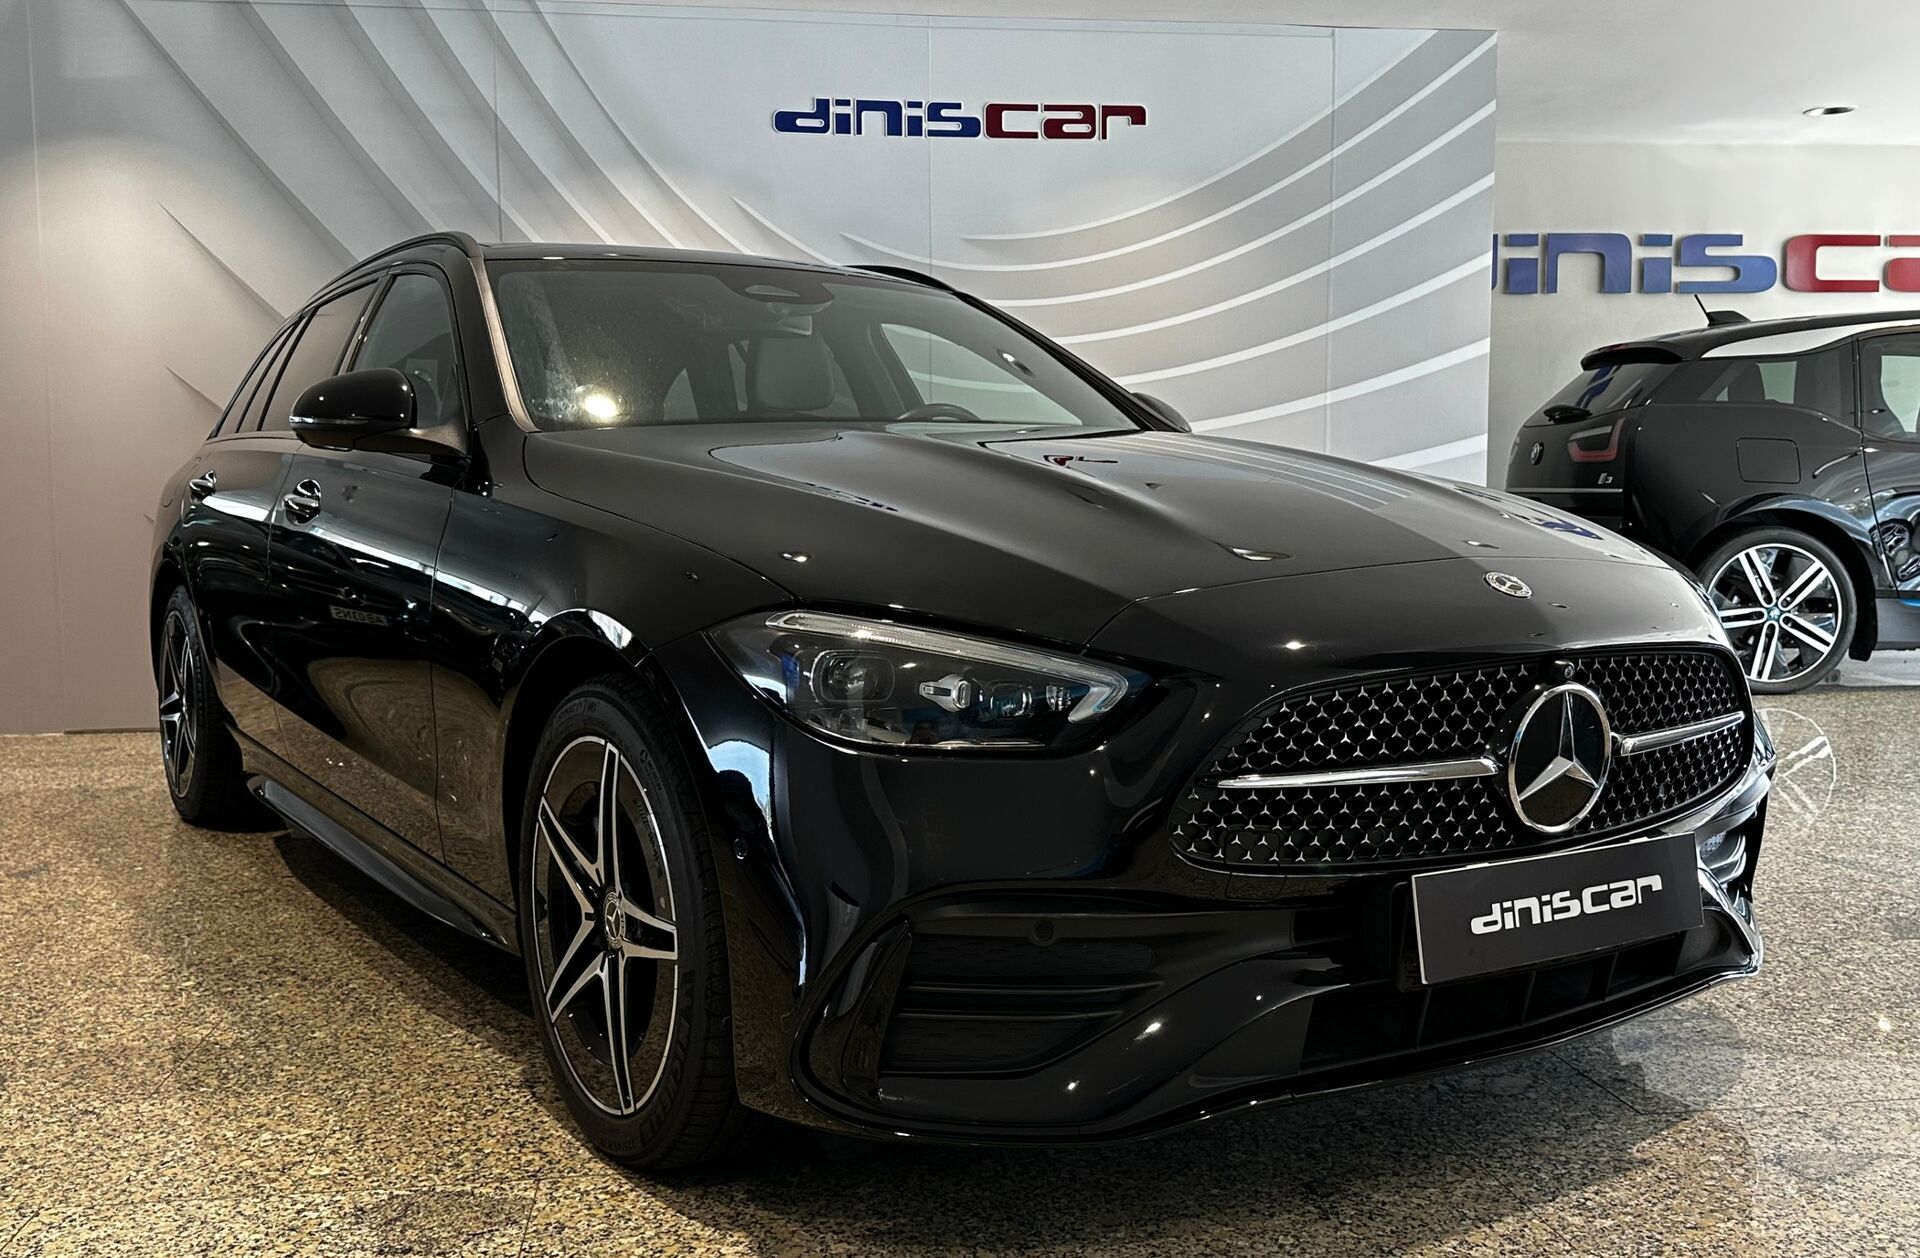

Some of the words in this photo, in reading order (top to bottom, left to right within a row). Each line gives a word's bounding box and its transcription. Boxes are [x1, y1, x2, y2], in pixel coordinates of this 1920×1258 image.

[772, 96, 1148, 141] diniscar
[1492, 232, 1920, 294] inisc
[1470, 873, 1663, 935] diniscar
[640, 1014, 691, 1147] MICHELIN
